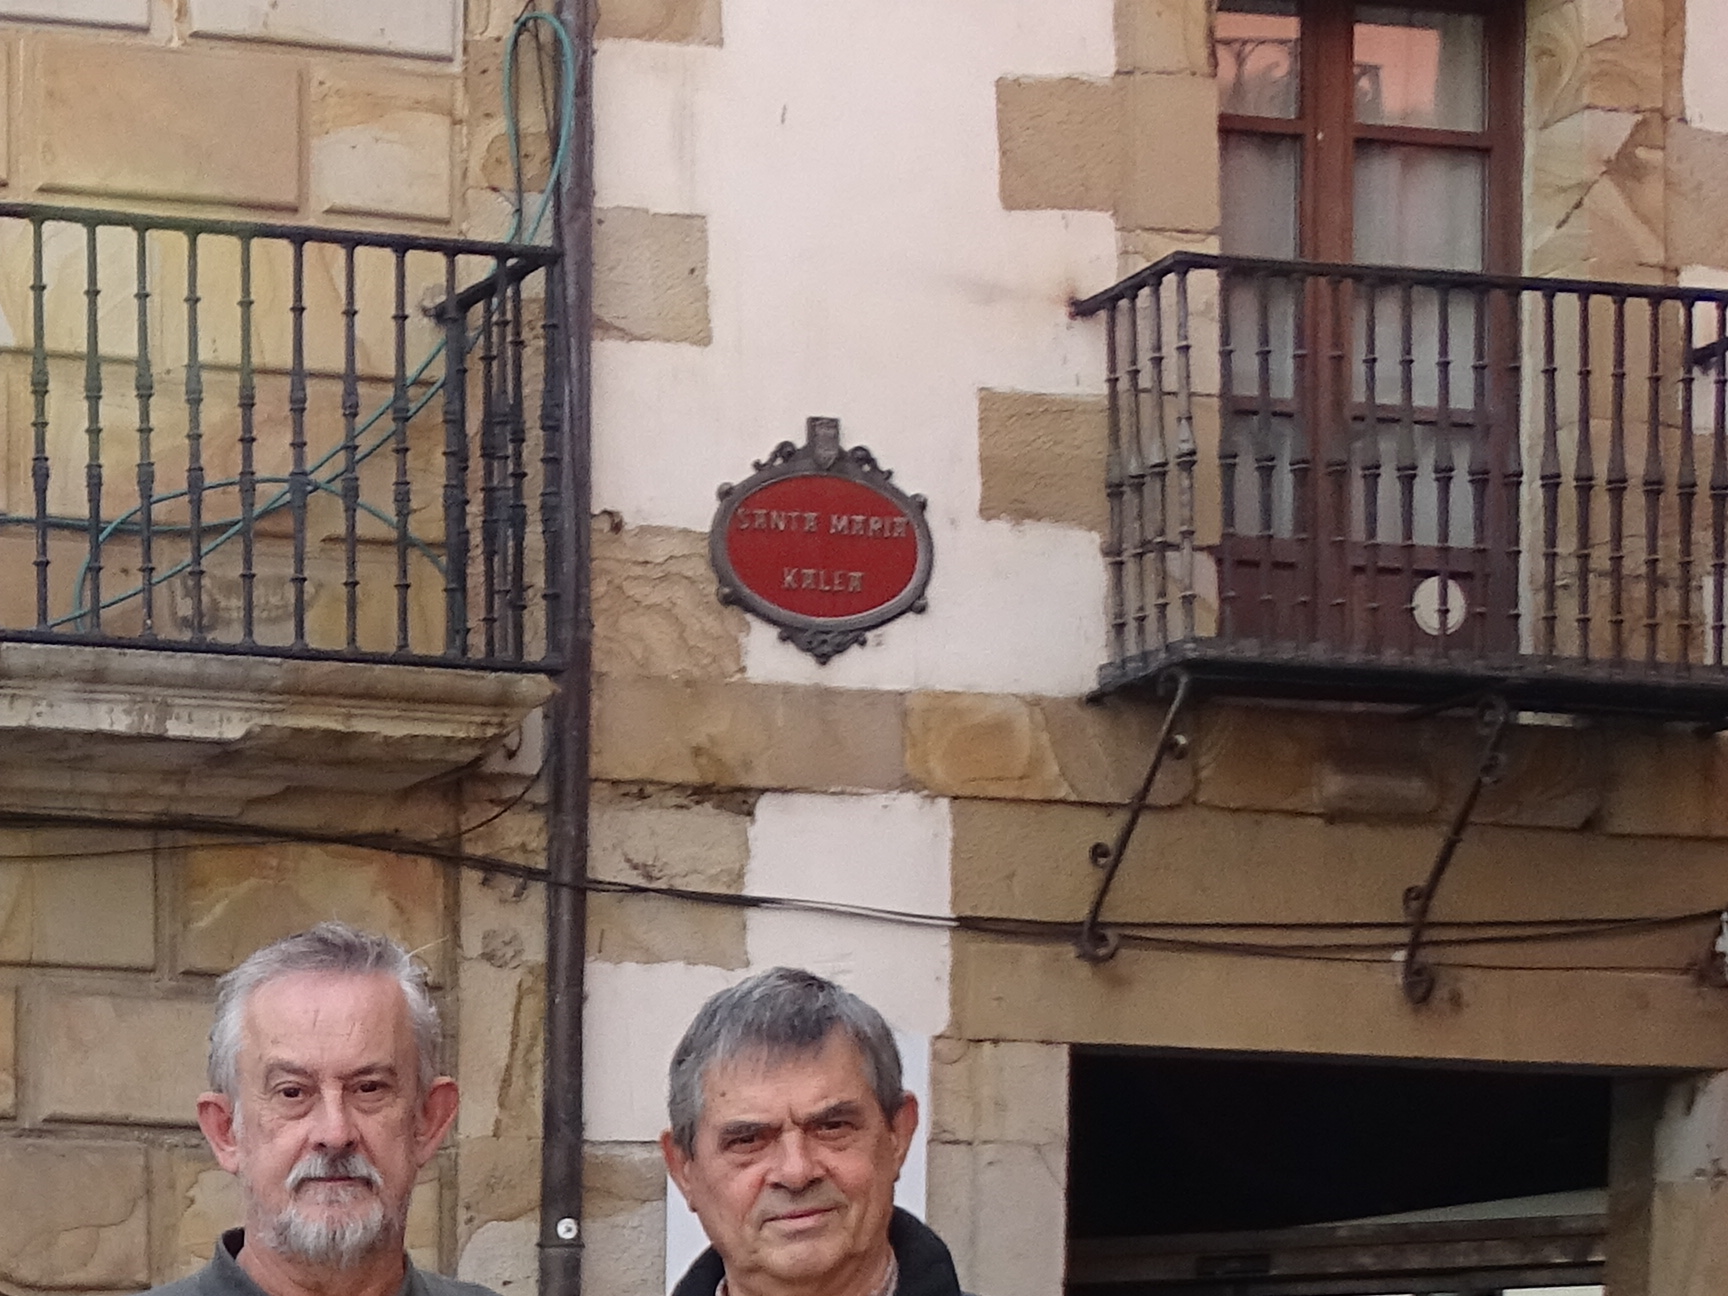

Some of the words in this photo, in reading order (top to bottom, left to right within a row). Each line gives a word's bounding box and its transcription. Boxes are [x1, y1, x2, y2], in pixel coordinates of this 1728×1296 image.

[737, 509, 818, 531] SANTA
[830, 514, 910, 537] MARIA
[782, 568, 863, 591] KALEA
